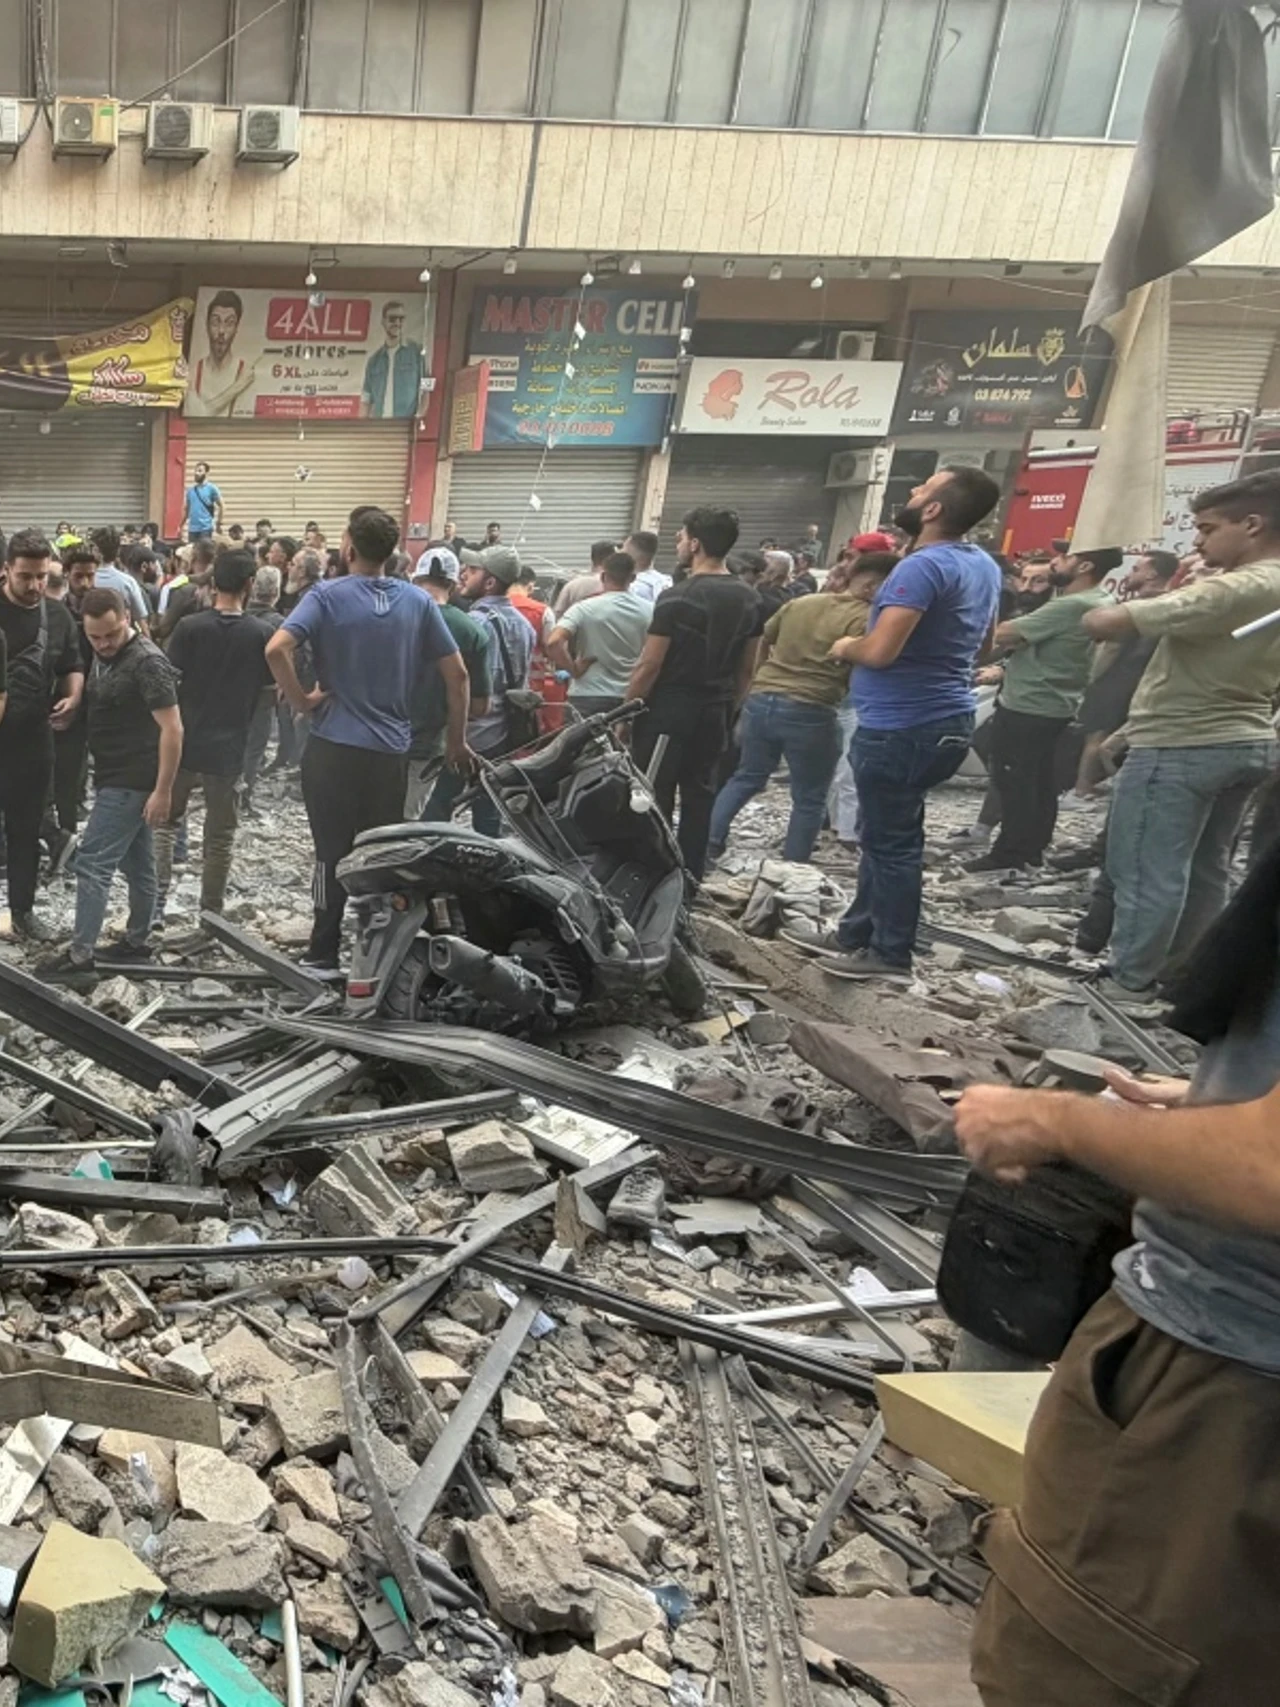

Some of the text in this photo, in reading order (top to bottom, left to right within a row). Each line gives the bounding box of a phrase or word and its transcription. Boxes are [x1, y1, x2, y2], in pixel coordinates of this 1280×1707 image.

[273, 301, 363, 336] 4ALL
[283, 343, 348, 359] stores
[961, 326, 1033, 369] سلمان
[757, 369, 862, 413] Rola
[1031, 493, 1066, 503] IVECO
